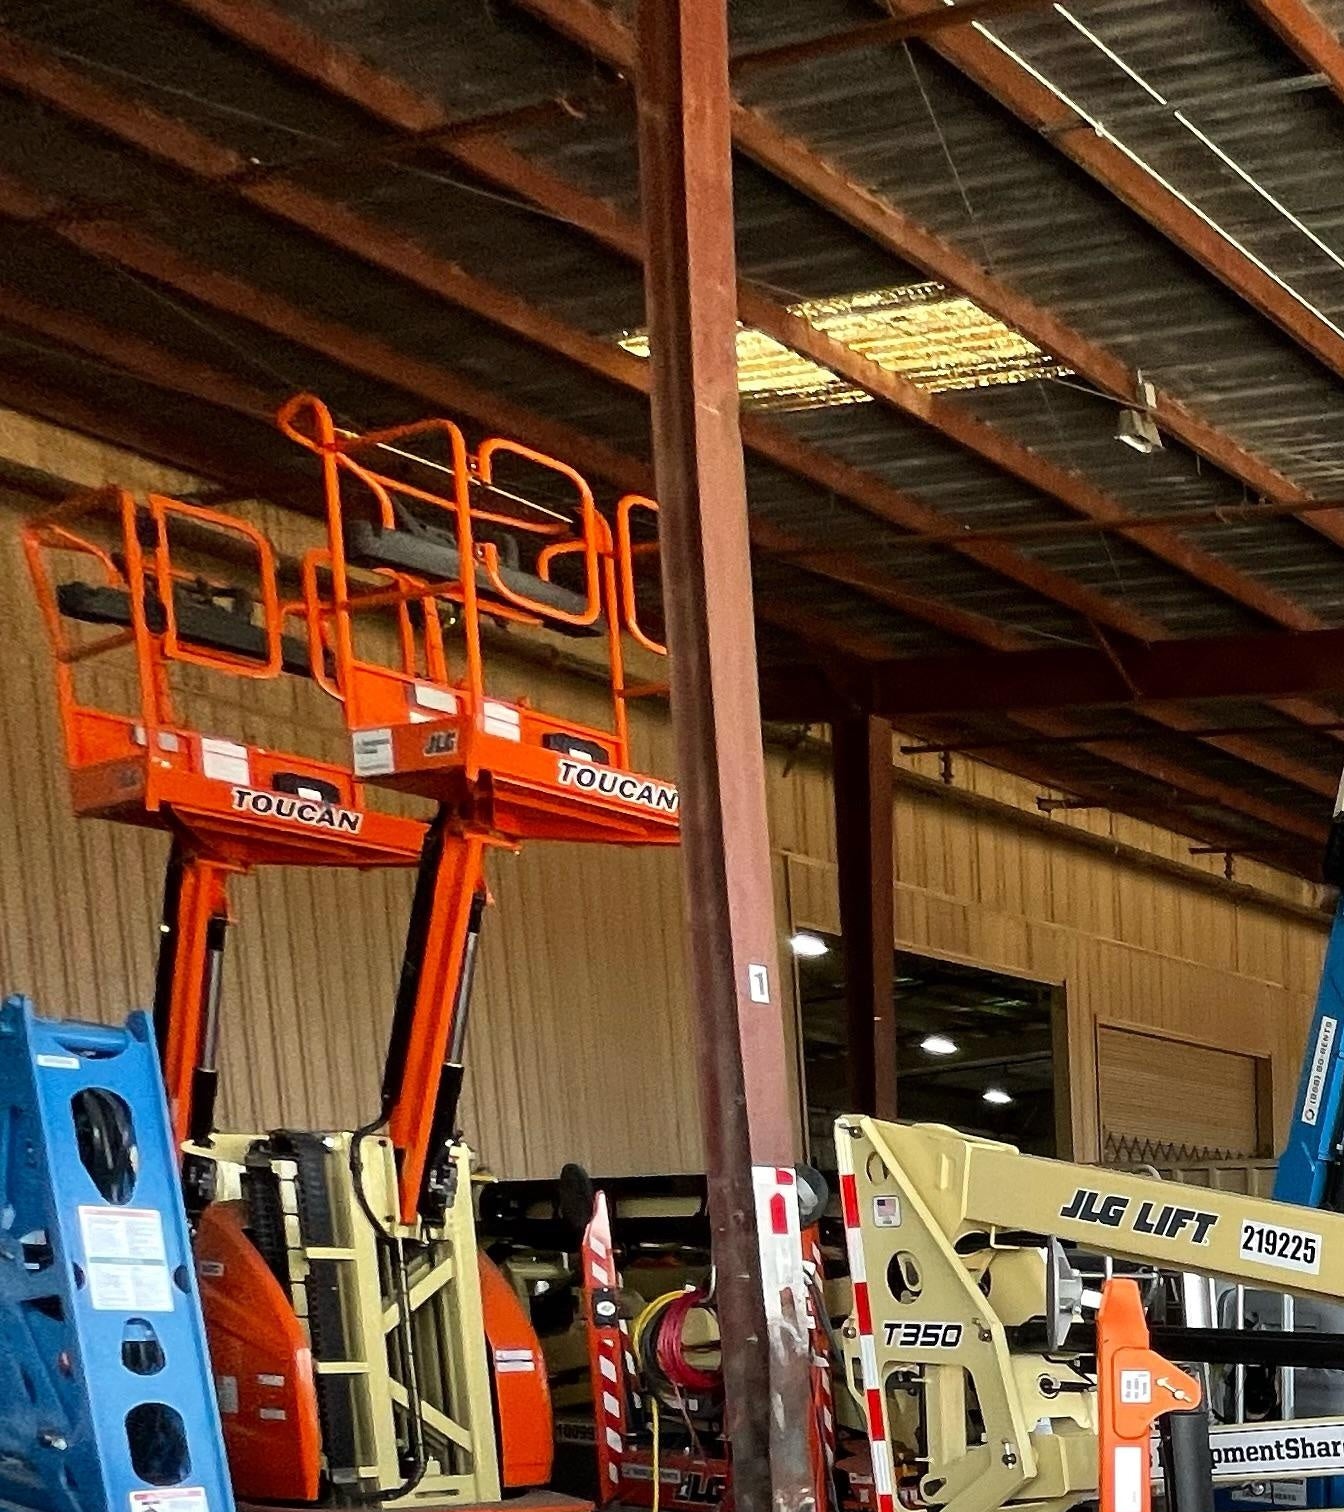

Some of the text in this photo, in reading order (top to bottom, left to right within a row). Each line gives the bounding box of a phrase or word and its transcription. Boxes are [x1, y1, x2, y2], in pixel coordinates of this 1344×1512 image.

[561, 761, 679, 810] TOUCAN
[235, 789, 360, 832] TOUCAN
[753, 972, 765, 995] 1
[1060, 1189, 1219, 1244] JLG LIFT
[1242, 1225, 1316, 1264] 219225
[884, 1322, 962, 1348] T350
